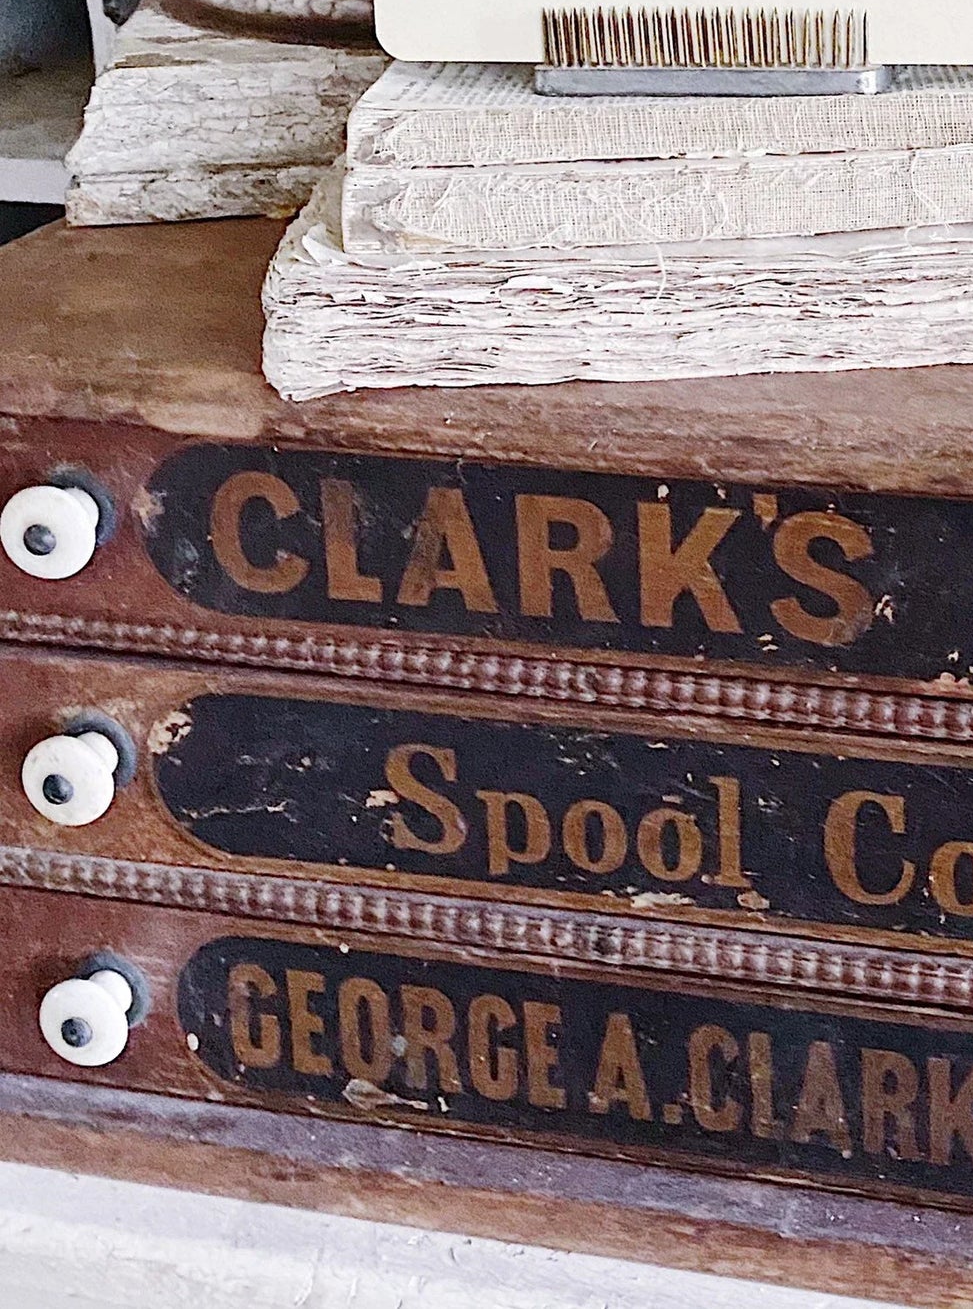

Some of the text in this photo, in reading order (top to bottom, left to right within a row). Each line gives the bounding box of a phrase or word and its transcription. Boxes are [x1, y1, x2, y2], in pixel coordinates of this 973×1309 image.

[208, 471, 873, 647] CLARK'S
[383, 743, 752, 888] Spool
[227, 963, 568, 1112] GEORGE
